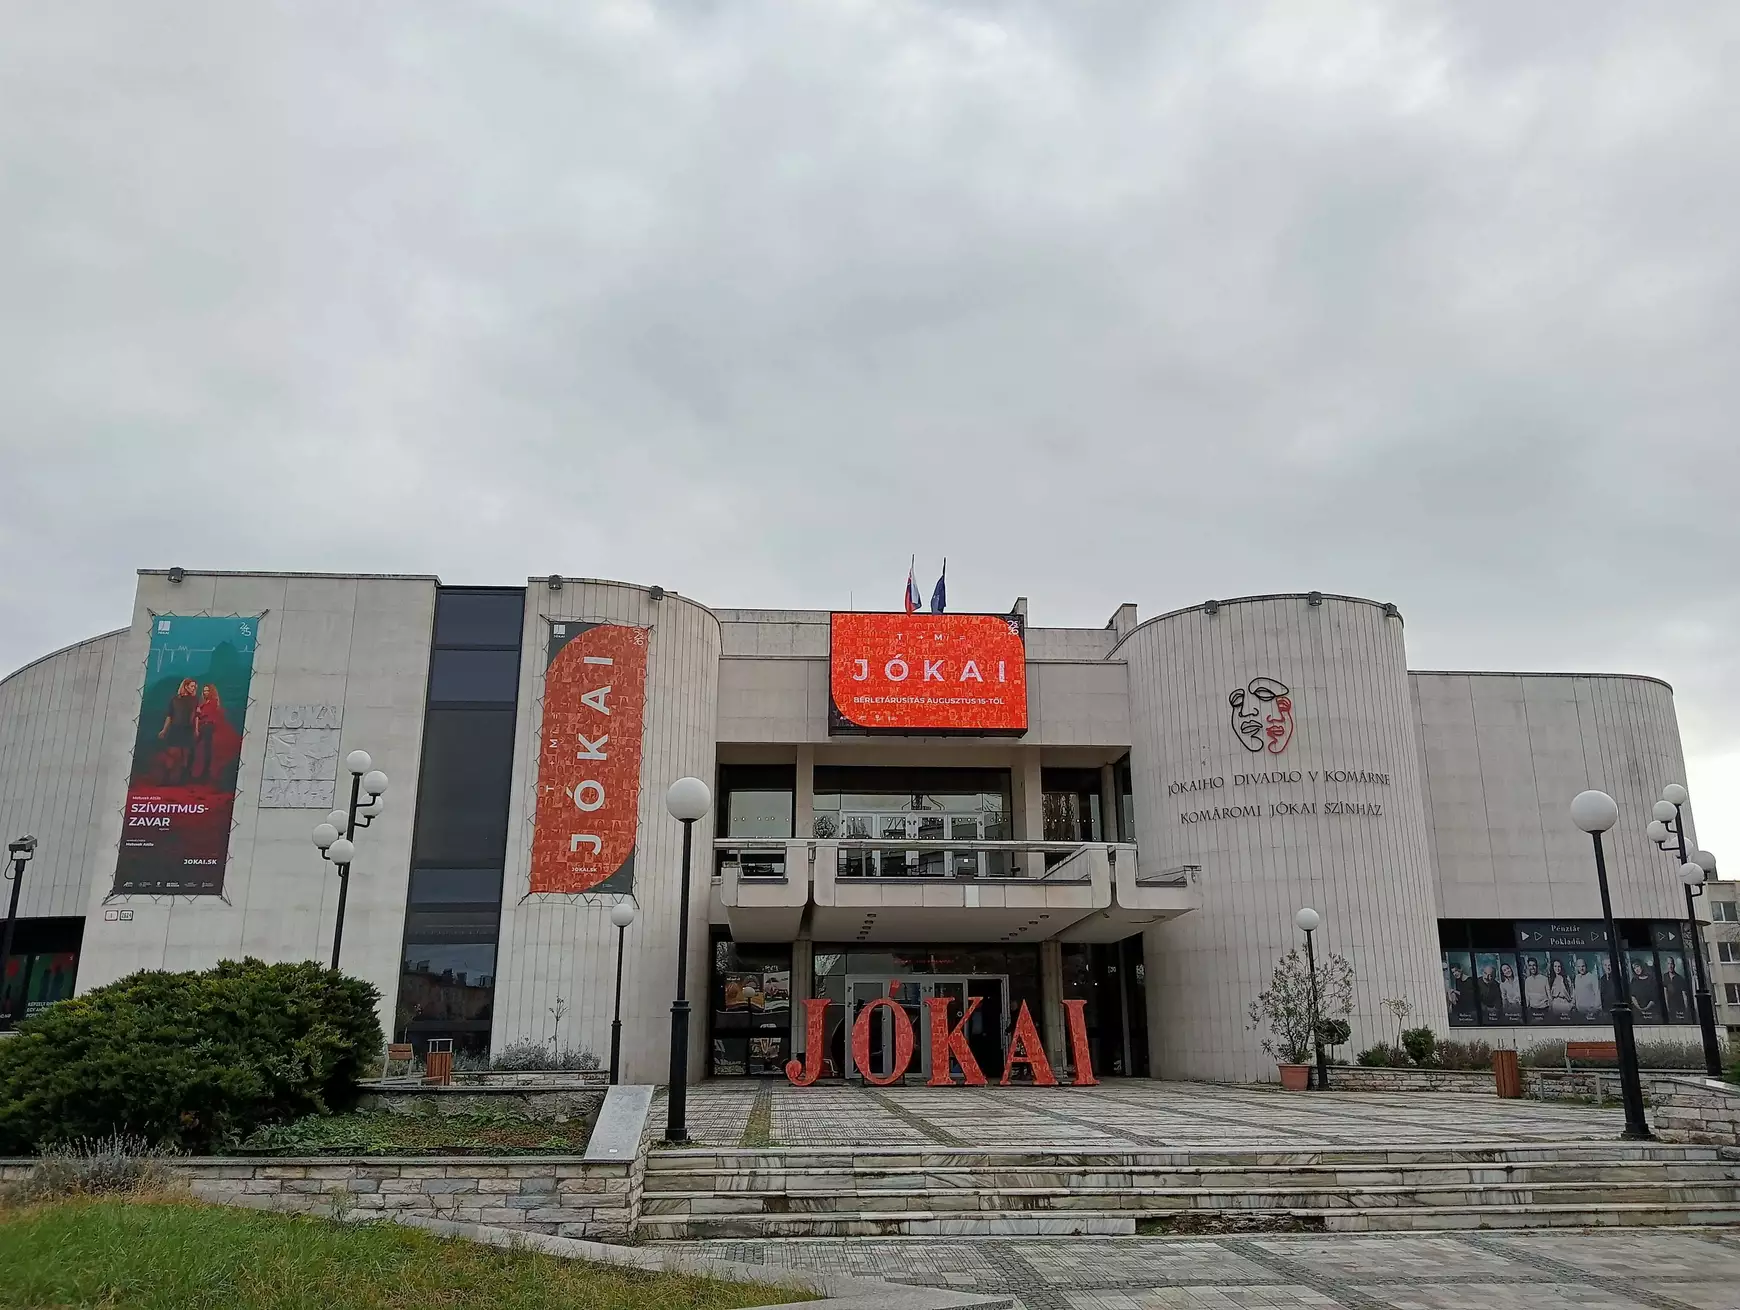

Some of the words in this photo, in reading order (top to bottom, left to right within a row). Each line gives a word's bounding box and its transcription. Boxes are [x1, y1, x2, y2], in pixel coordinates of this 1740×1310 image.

[852, 653, 1006, 683] JÓKAI
[565, 656, 614, 856] JÓKAI
[1168, 776, 1225, 799] JÓKAIHO
[1234, 771, 1302, 786] DIVADLO
[1308, 770, 1319, 783] V
[1325, 770, 1391, 786] KOMÁRNE
[129, 817, 171, 827] ZAVAR
[131, 801, 209, 814] SZÍVRITMUS-
[1181, 805, 1262, 825] KOMÁROMI
[1269, 801, 1317, 818] JÓKAI
[1324, 800, 1383, 816] SZÍNHÁZ
[785, 979, 1100, 1087] JÓKAI
